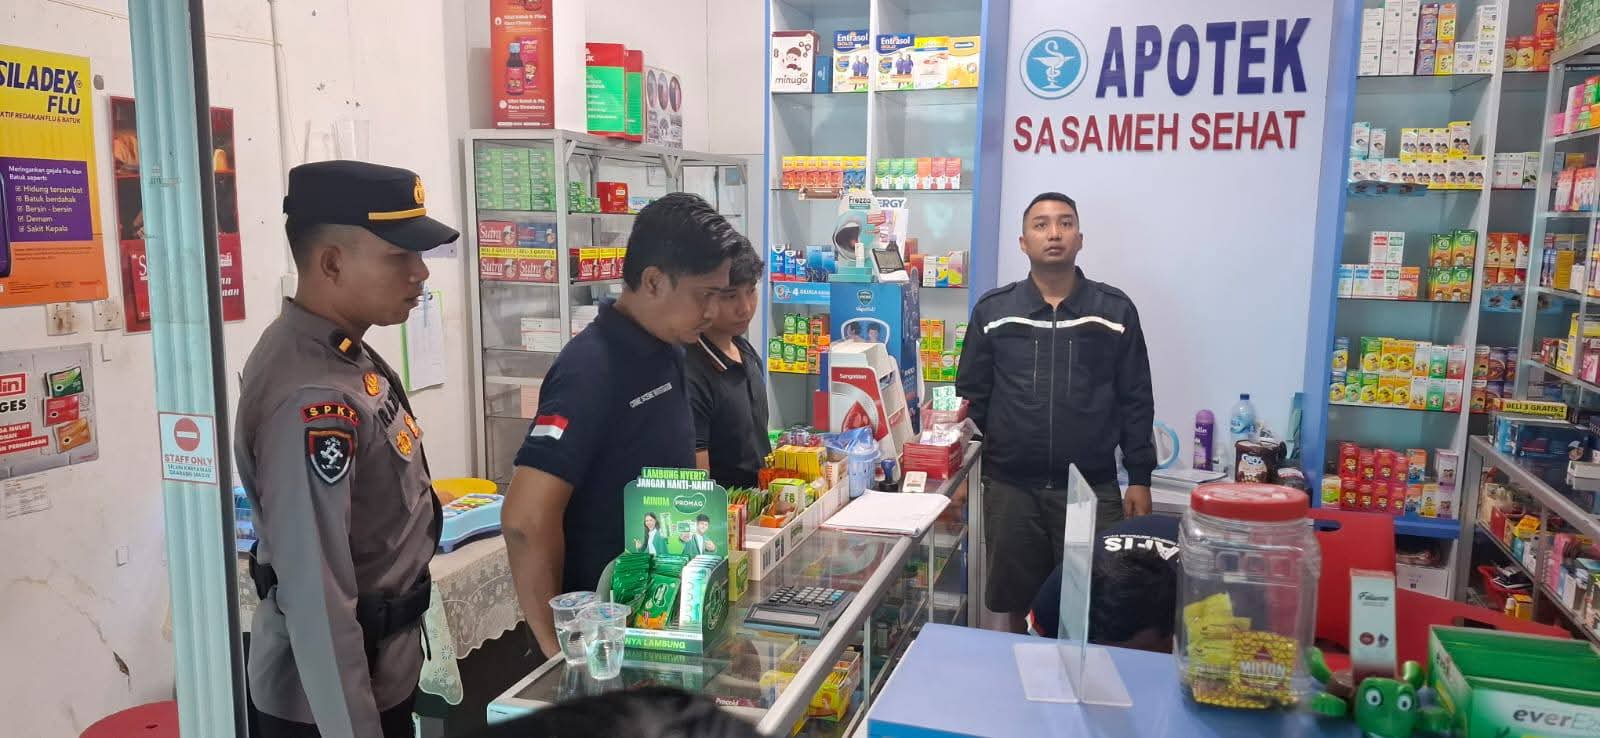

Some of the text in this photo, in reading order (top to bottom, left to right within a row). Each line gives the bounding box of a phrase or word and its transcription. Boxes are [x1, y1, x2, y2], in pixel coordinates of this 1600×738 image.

[837, 32, 868, 42] Entrasol
[881, 37, 910, 45] Entrasol
[1096, 18, 1311, 98] APOTEK
[0, 61, 78, 95] SILADEX
[47, 96, 80, 115] FLU
[15, 113, 44, 121] REDAKAN
[1013, 110, 1306, 153] SASAMEH SEHAT
[24, 185, 48, 194] Hidung
[46, 195, 76, 203] berdahak
[46, 225, 69, 233] Kepala
[480, 225, 502, 239] Sutra
[481, 260, 503, 273] Sutra
[520, 261, 542, 275] Sutra
[0, 399, 27, 413] GES
[309, 405, 355, 419] SPKT
[1506, 402, 1522, 410] BELI
[1530, 404, 1558, 412] GRATIS
[164, 454, 212, 466] STAFF ONLY
[643, 468, 706, 481] LAMBUNG NYERI?
[636, 478, 714, 491] JANGAN NANTI-NANTI
[643, 495, 670, 507] MINUM
[643, 639, 686, 649] LAMBUNG
[1239, 661, 1285, 677] MILTON
